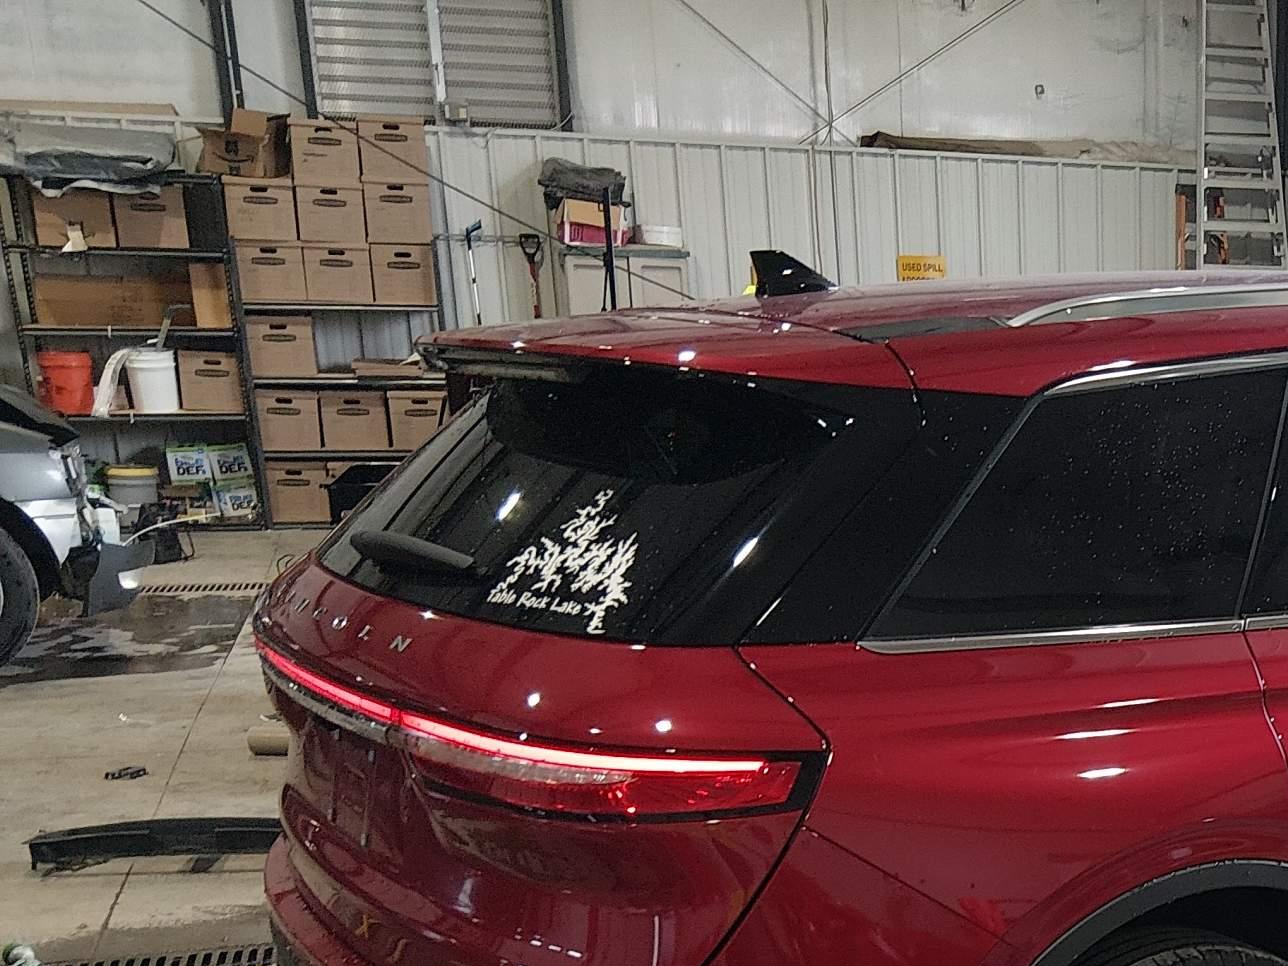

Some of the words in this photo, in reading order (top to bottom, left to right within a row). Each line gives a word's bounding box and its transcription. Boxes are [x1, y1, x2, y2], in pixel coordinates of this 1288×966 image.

[902, 262, 922, 272] USED
[923, 263, 944, 273] SPILL
[487, 588, 517, 605] Table
[516, 591, 551, 609] Rock
[550, 597, 582, 616] Lake
